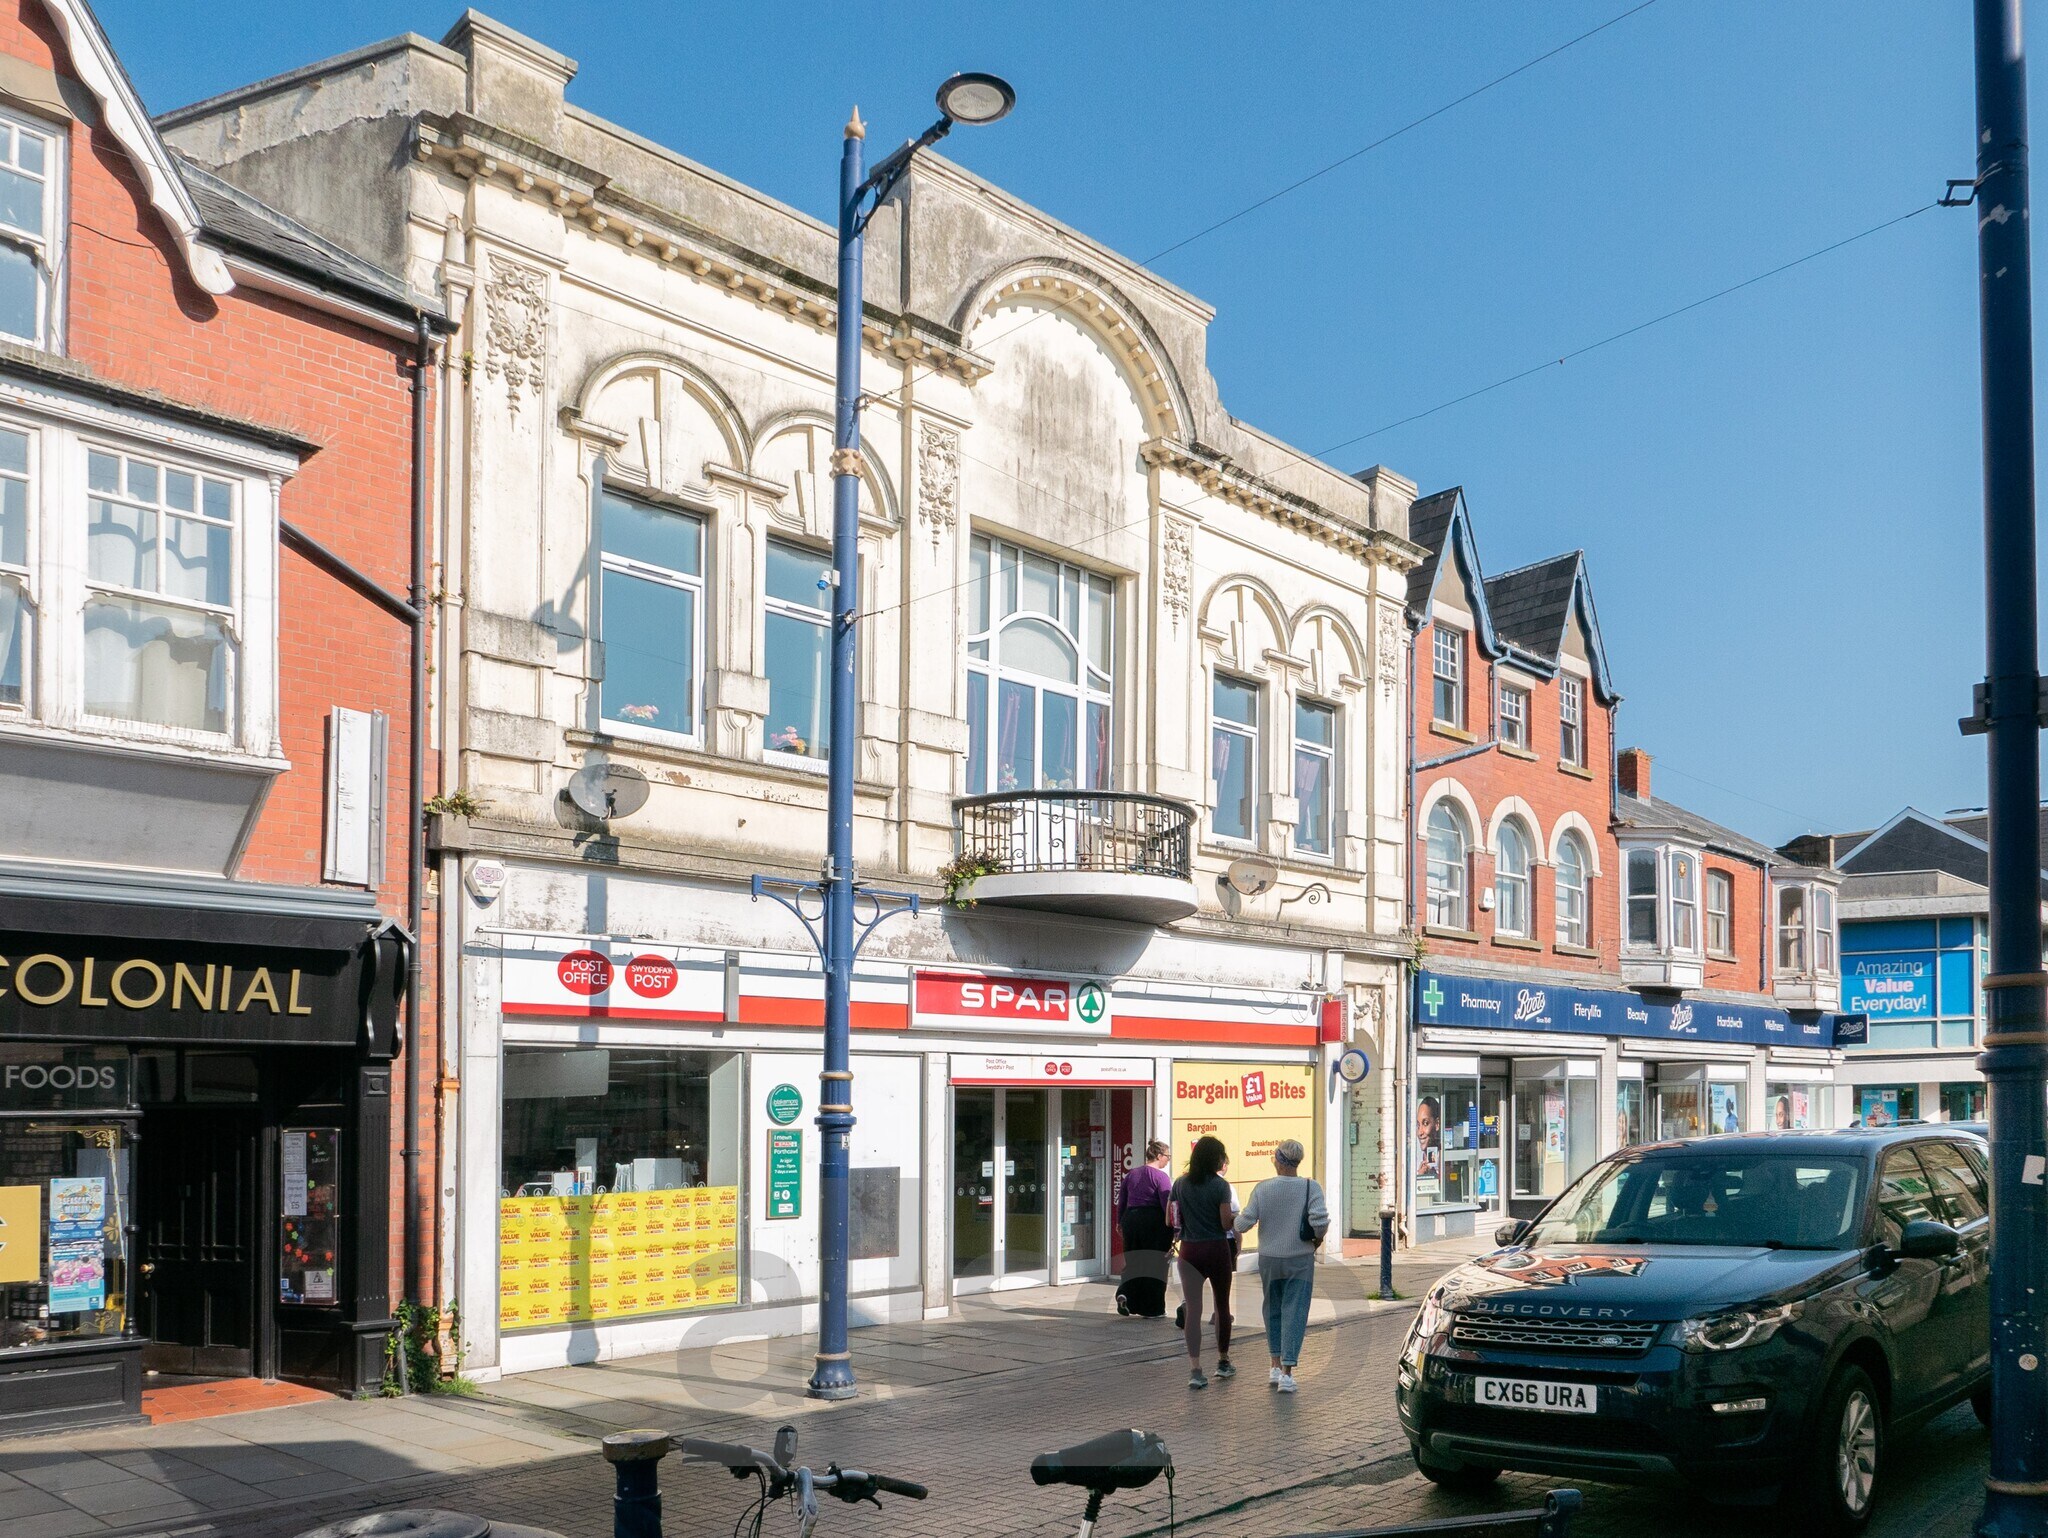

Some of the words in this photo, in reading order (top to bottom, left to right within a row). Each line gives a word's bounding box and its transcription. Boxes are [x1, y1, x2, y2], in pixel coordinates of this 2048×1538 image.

[571, 959, 604, 972] POST
[1855, 959, 1923, 976] Amazing
[0, 953, 312, 1015] OLONIAL
[563, 971, 608, 985] OFFICE
[634, 975, 671, 989] POST
[1864, 979, 1914, 994] Value
[961, 983, 1067, 1013] SPAR
[1461, 993, 1501, 1014] Pharmacy
[1514, 988, 1546, 1022] Boots
[1851, 994, 1927, 1013] Everyday!
[1627, 1007, 1648, 1025] Beauty
[1669, 1003, 1694, 1032] Boots
[1837, 1021, 1864, 1036] Boots
[5, 1065, 115, 1089] FOODS
[1245, 1075, 1261, 1094] £1
[1177, 1080, 1238, 1104] Bargain
[1246, 1093, 1263, 1103] Value
[1270, 1080, 1305, 1099] Bites
[1187, 1122, 1217, 1134] Bargain
[1477, 1302, 1634, 1318] DISCOVERY
[1485, 1381, 1538, 1404] CX66
[1545, 1385, 1587, 1408] URA
